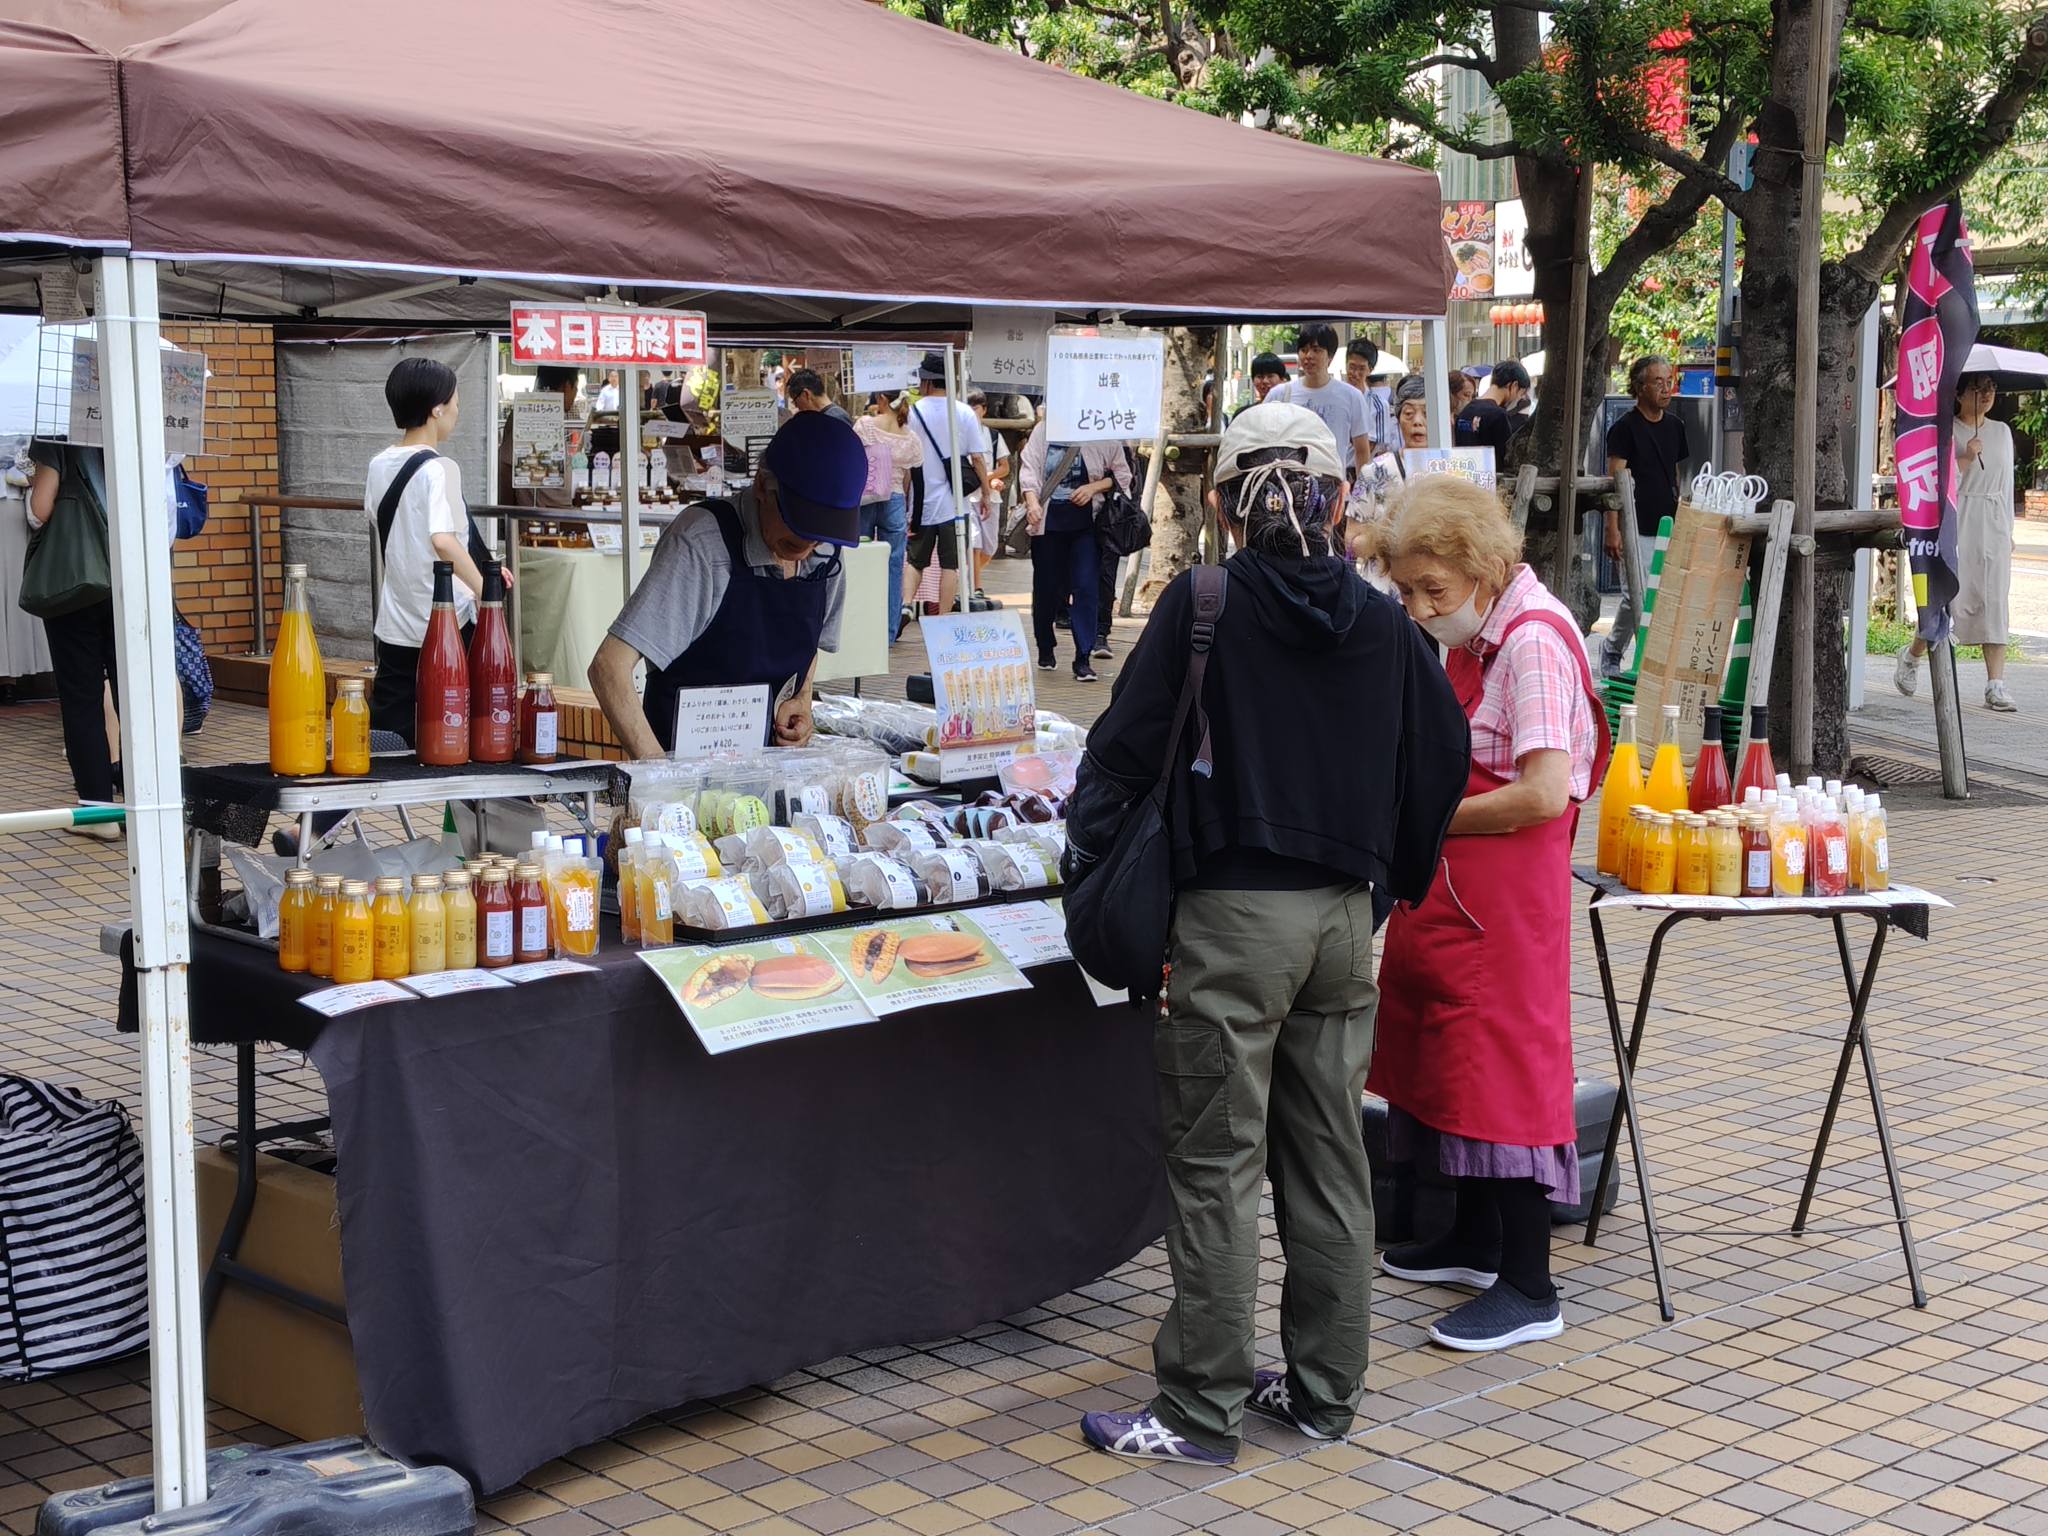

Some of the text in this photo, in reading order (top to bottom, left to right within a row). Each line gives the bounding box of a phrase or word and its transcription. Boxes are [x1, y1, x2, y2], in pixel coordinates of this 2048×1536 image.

[516, 312, 704, 359] 本日最終日
[1097, 372, 1121, 388] 出雲
[724, 399, 776, 411] デーツシロップ
[1077, 408, 1137, 431] どらやき
[1704, 620, 1723, 685] コーンバー
